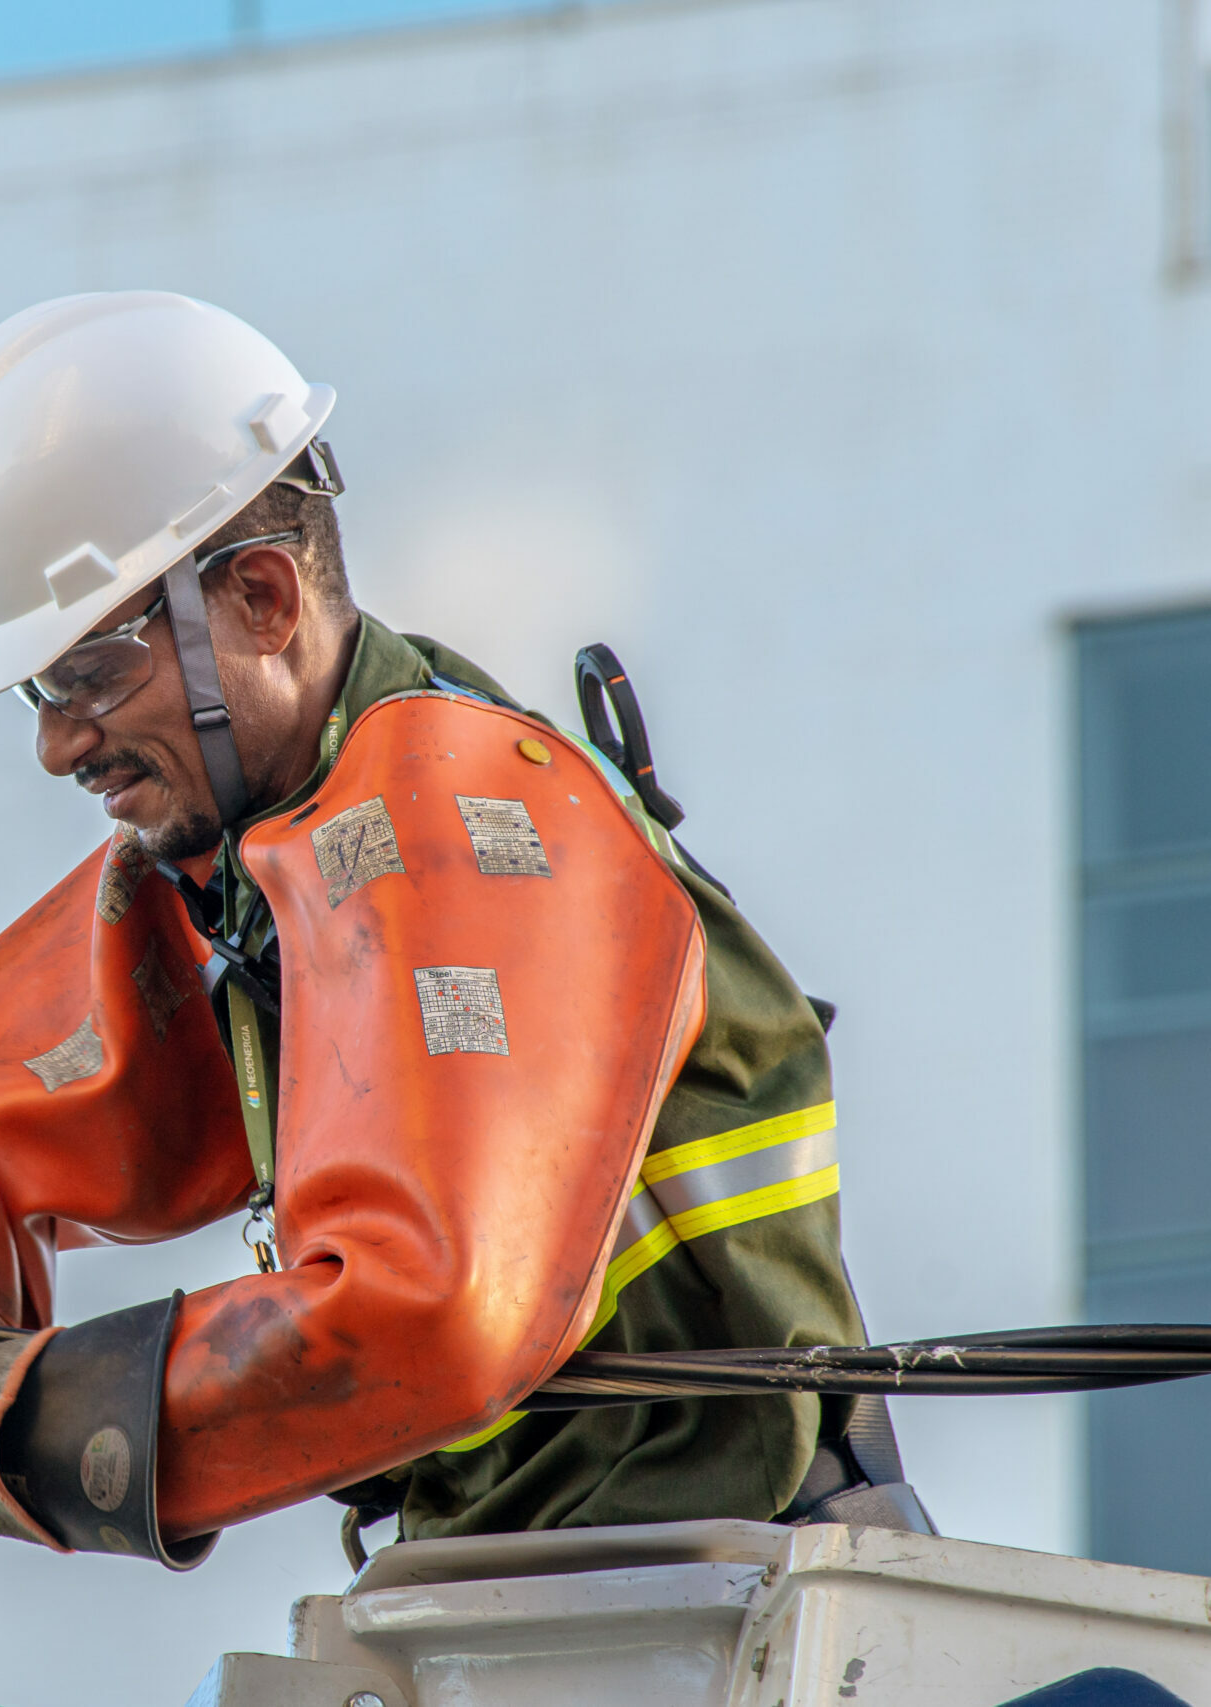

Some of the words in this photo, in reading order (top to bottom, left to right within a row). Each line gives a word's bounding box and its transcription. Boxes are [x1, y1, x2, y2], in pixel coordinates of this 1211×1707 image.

[328, 725, 339, 771] NEOENE
[428, 969, 453, 979] Steel
[240, 1024, 258, 1089] NEOENERGIA
